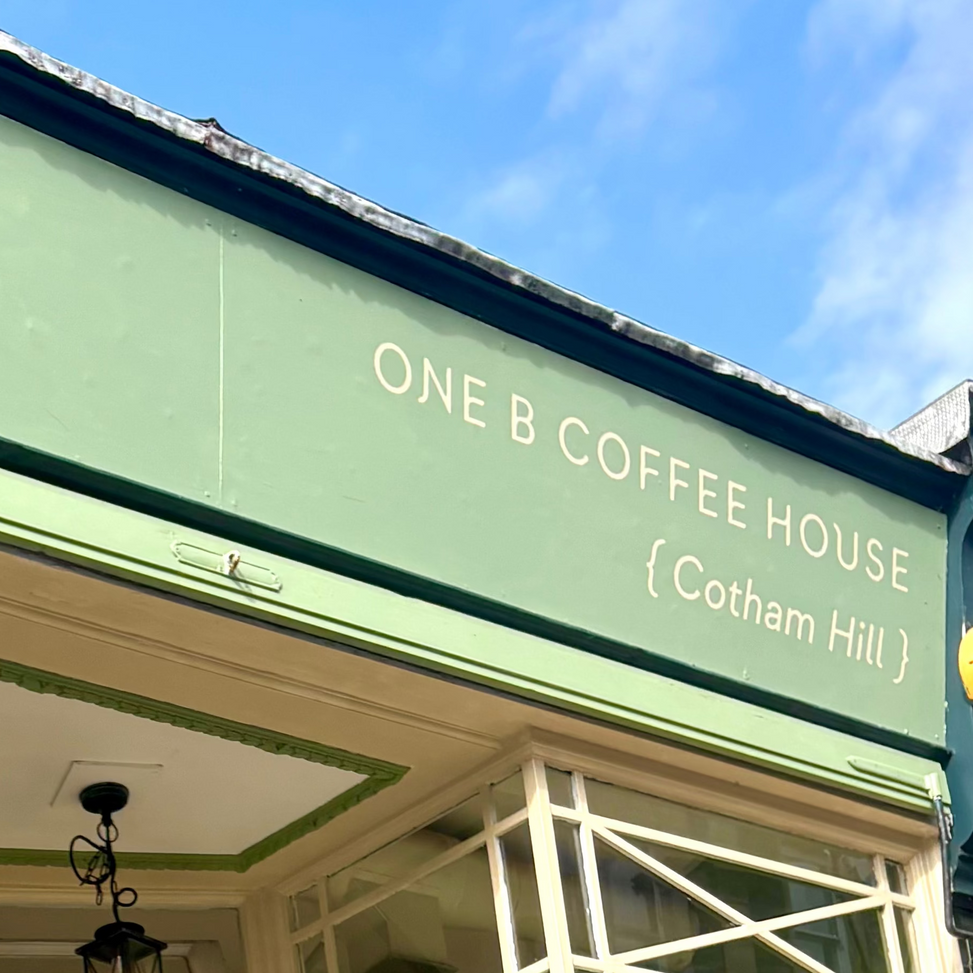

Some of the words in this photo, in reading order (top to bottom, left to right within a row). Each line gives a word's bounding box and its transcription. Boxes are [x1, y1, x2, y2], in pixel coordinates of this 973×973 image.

[373, 342, 487, 429] ONE
[510, 392, 536, 446] B
[558, 416, 747, 530] COFFEE
[767, 496, 910, 593] HOUSE
